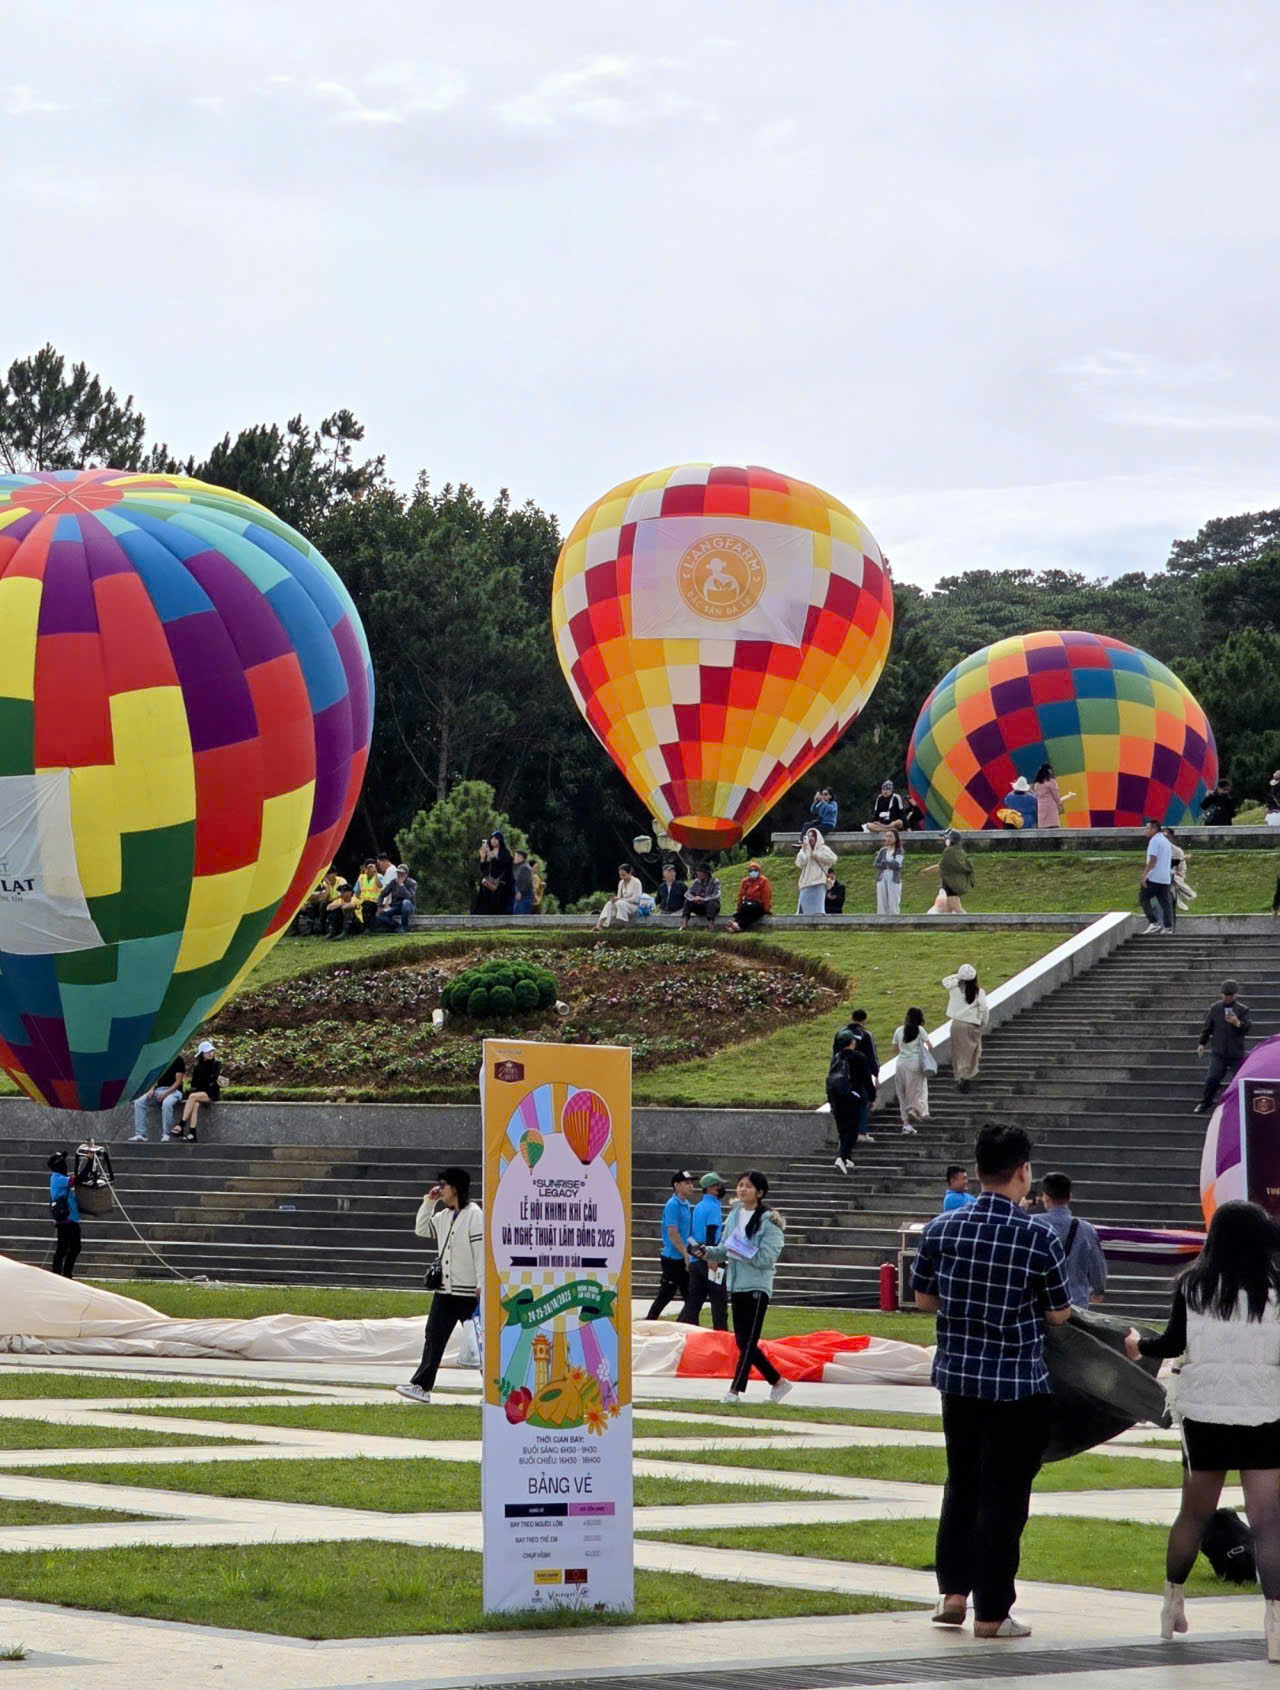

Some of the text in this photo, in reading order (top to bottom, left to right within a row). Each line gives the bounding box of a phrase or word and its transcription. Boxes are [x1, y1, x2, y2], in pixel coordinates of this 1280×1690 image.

[0, 878, 36, 896] LẠT
[536, 1179, 580, 1188] SUNRISE
[539, 1189, 579, 1198] LEGACY
[520, 1195, 597, 1225] LỄ HỘI KHINH KHÍ CẦU
[502, 1222, 615, 1251] VÀ NGHỆ THUẬT LÂM ĐỒNG 2025
[536, 1434, 552, 1443] THỜI
[528, 1472, 593, 1495] BẢNG VÉ
